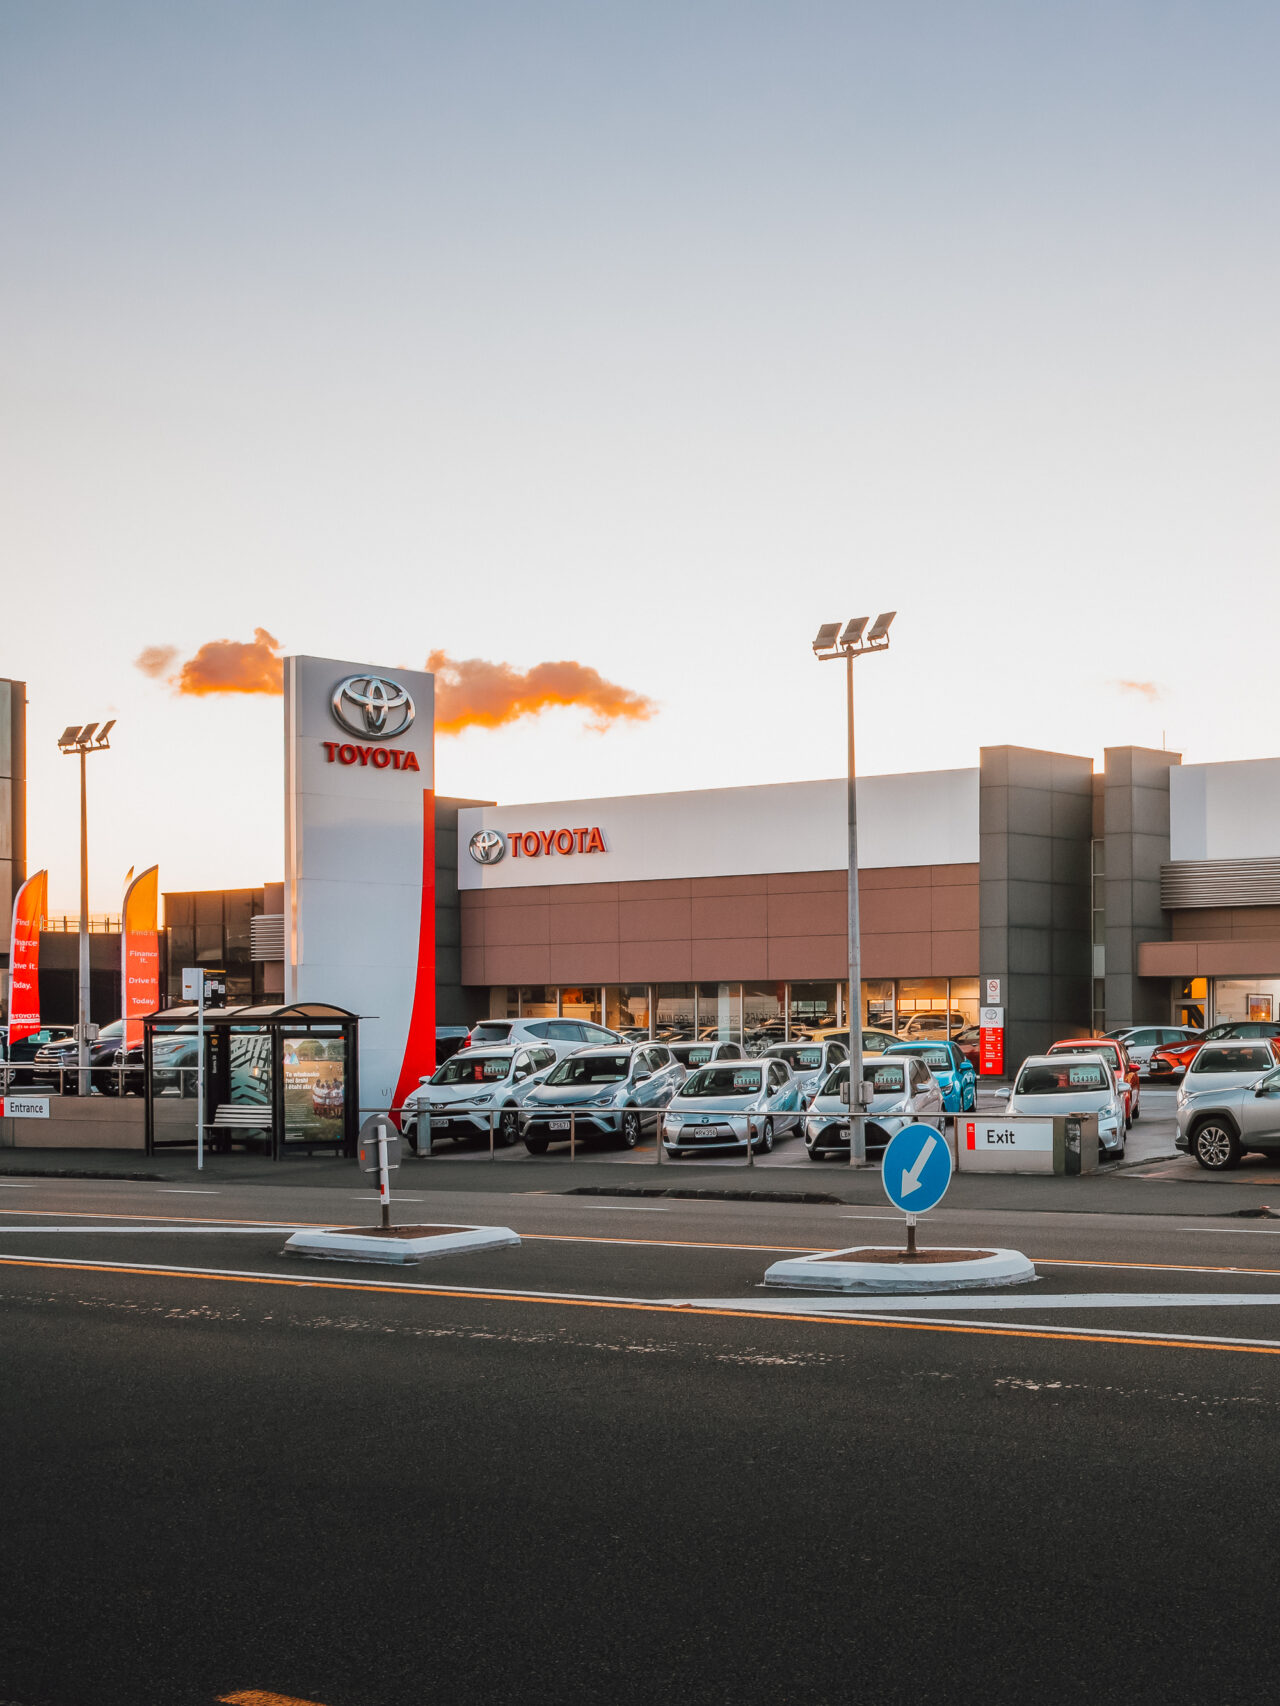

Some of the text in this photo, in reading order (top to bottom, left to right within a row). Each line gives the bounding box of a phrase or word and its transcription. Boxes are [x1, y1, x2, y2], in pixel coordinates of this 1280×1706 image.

[323, 741, 420, 772] TOYOTA
[507, 826, 606, 858] TOYOTA
[16, 919, 30, 927] Find
[10, 1101, 44, 1113] Entrance
[986, 1129, 1016, 1144] Exit
